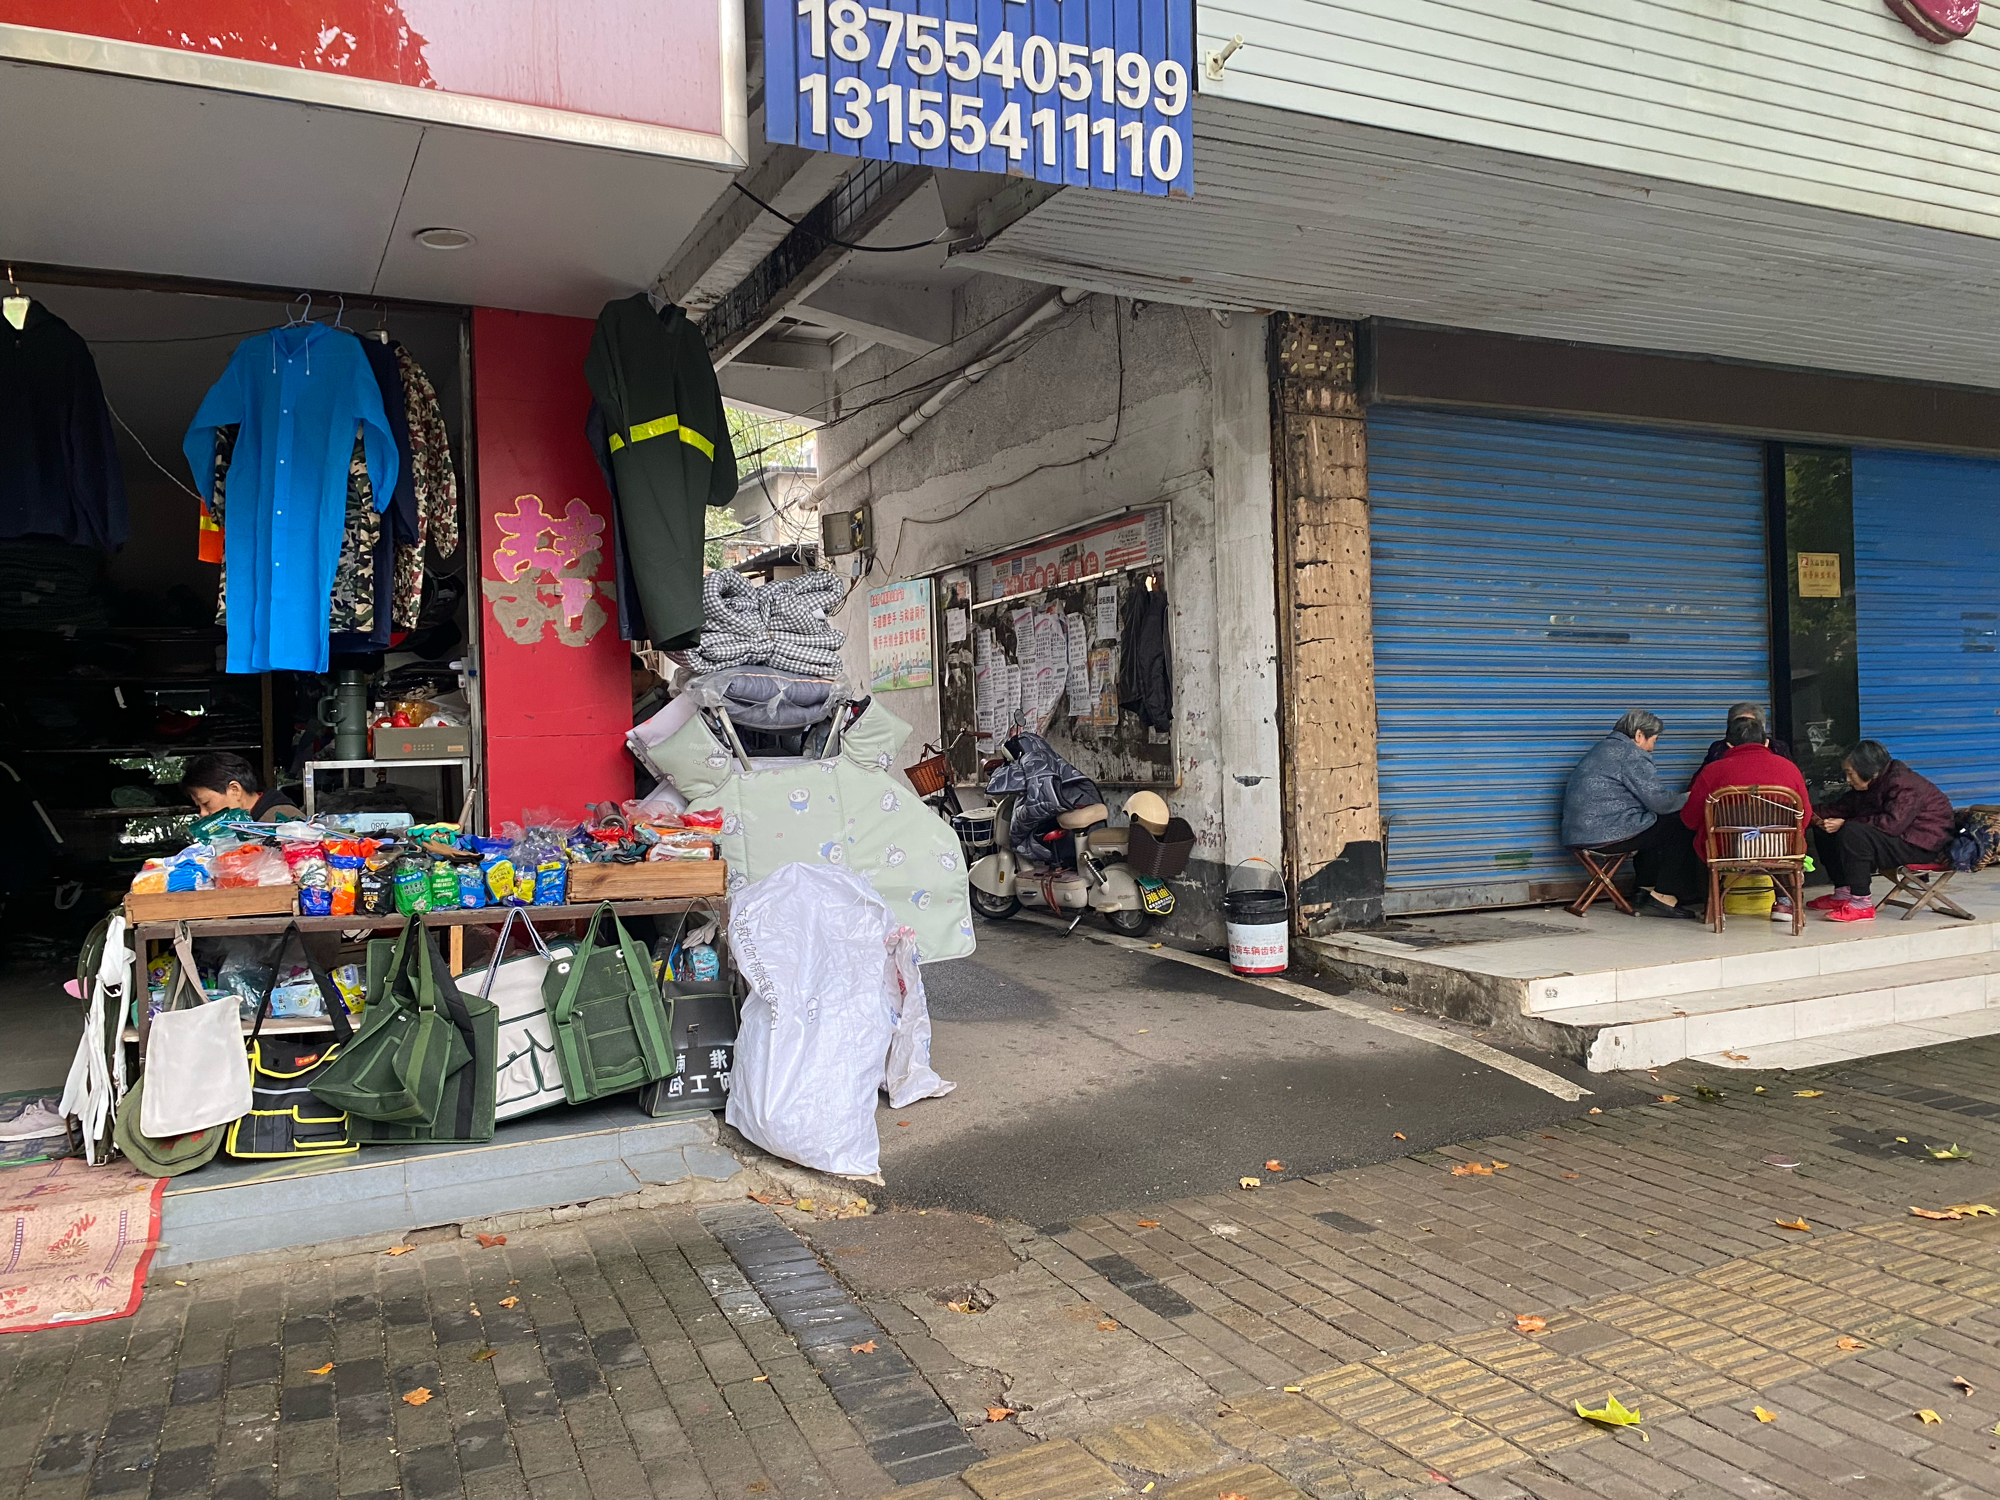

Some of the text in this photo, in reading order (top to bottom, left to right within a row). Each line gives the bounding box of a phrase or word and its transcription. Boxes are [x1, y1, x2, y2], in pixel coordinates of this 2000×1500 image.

[798, 0, 1188, 117] 18755405199
[798, 73, 1183, 182] 13155411110
[1003, 556, 1098, 597] 社区便民信息栏
[1146, 888, 1170, 904] 雅迪
[1229, 944, 1284, 955] 负荷车辆齿轮油
